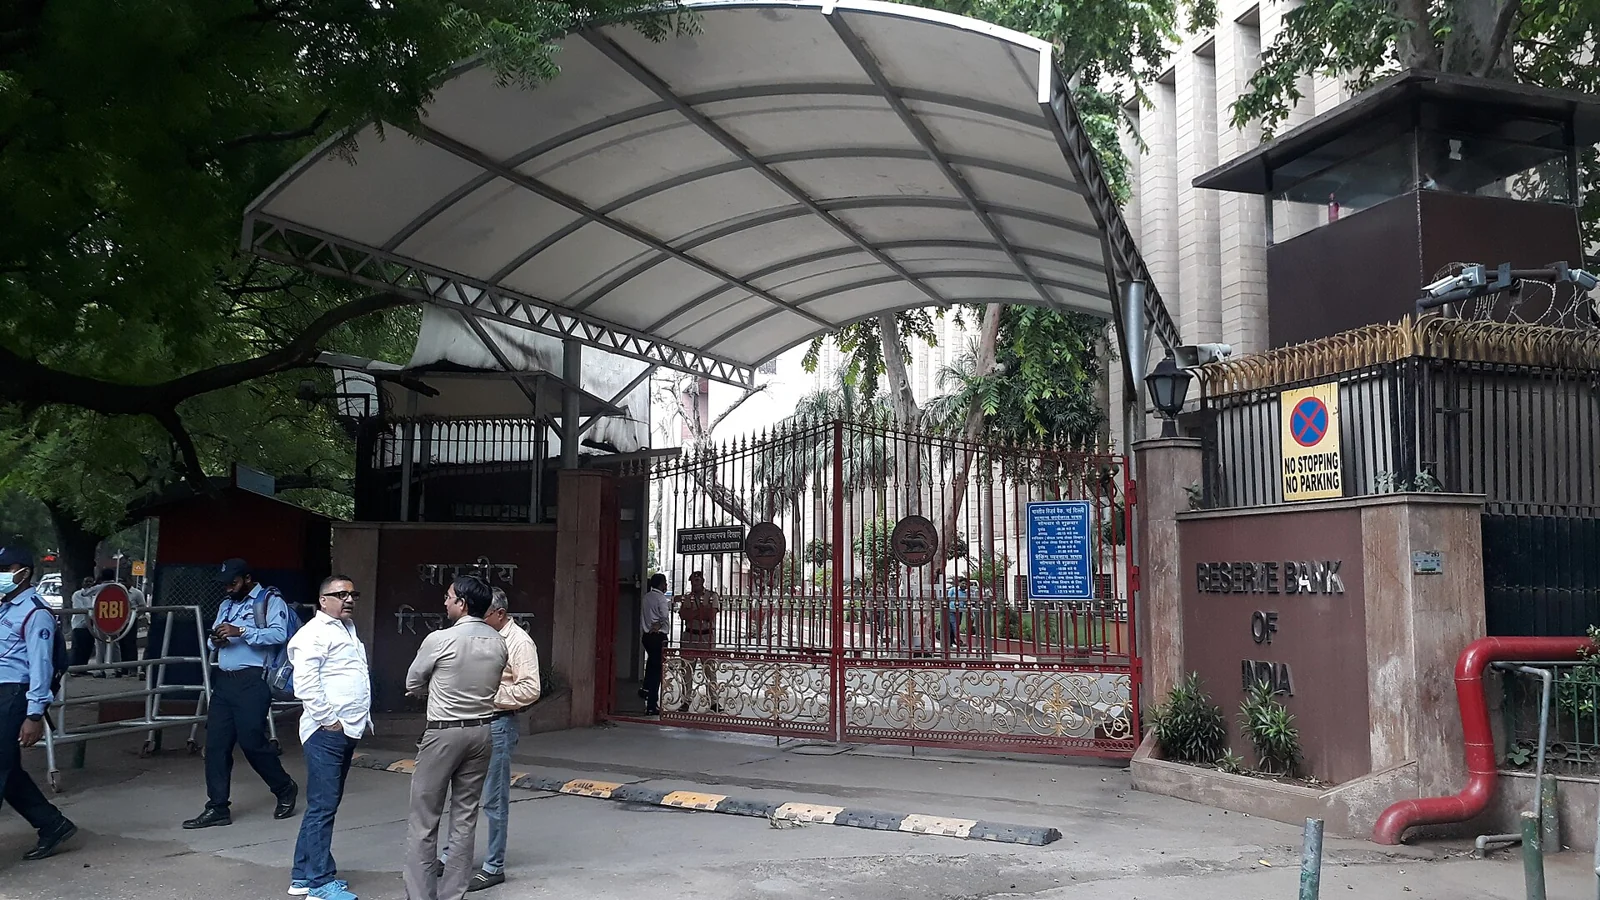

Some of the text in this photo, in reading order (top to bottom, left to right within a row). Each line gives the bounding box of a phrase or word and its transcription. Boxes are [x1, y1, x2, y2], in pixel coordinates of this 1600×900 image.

[1284, 451, 1339, 475] NO STOPPING
[1285, 471, 1340, 493] NO PARKING
[681, 541, 741, 552] PLEASE SHOW YOUR IDENTITY
[1196, 560, 1346, 595] RESERVE BANK
[98, 600, 124, 619] RBI
[1251, 610, 1279, 644] OF
[1241, 659, 1295, 697] INDIA
